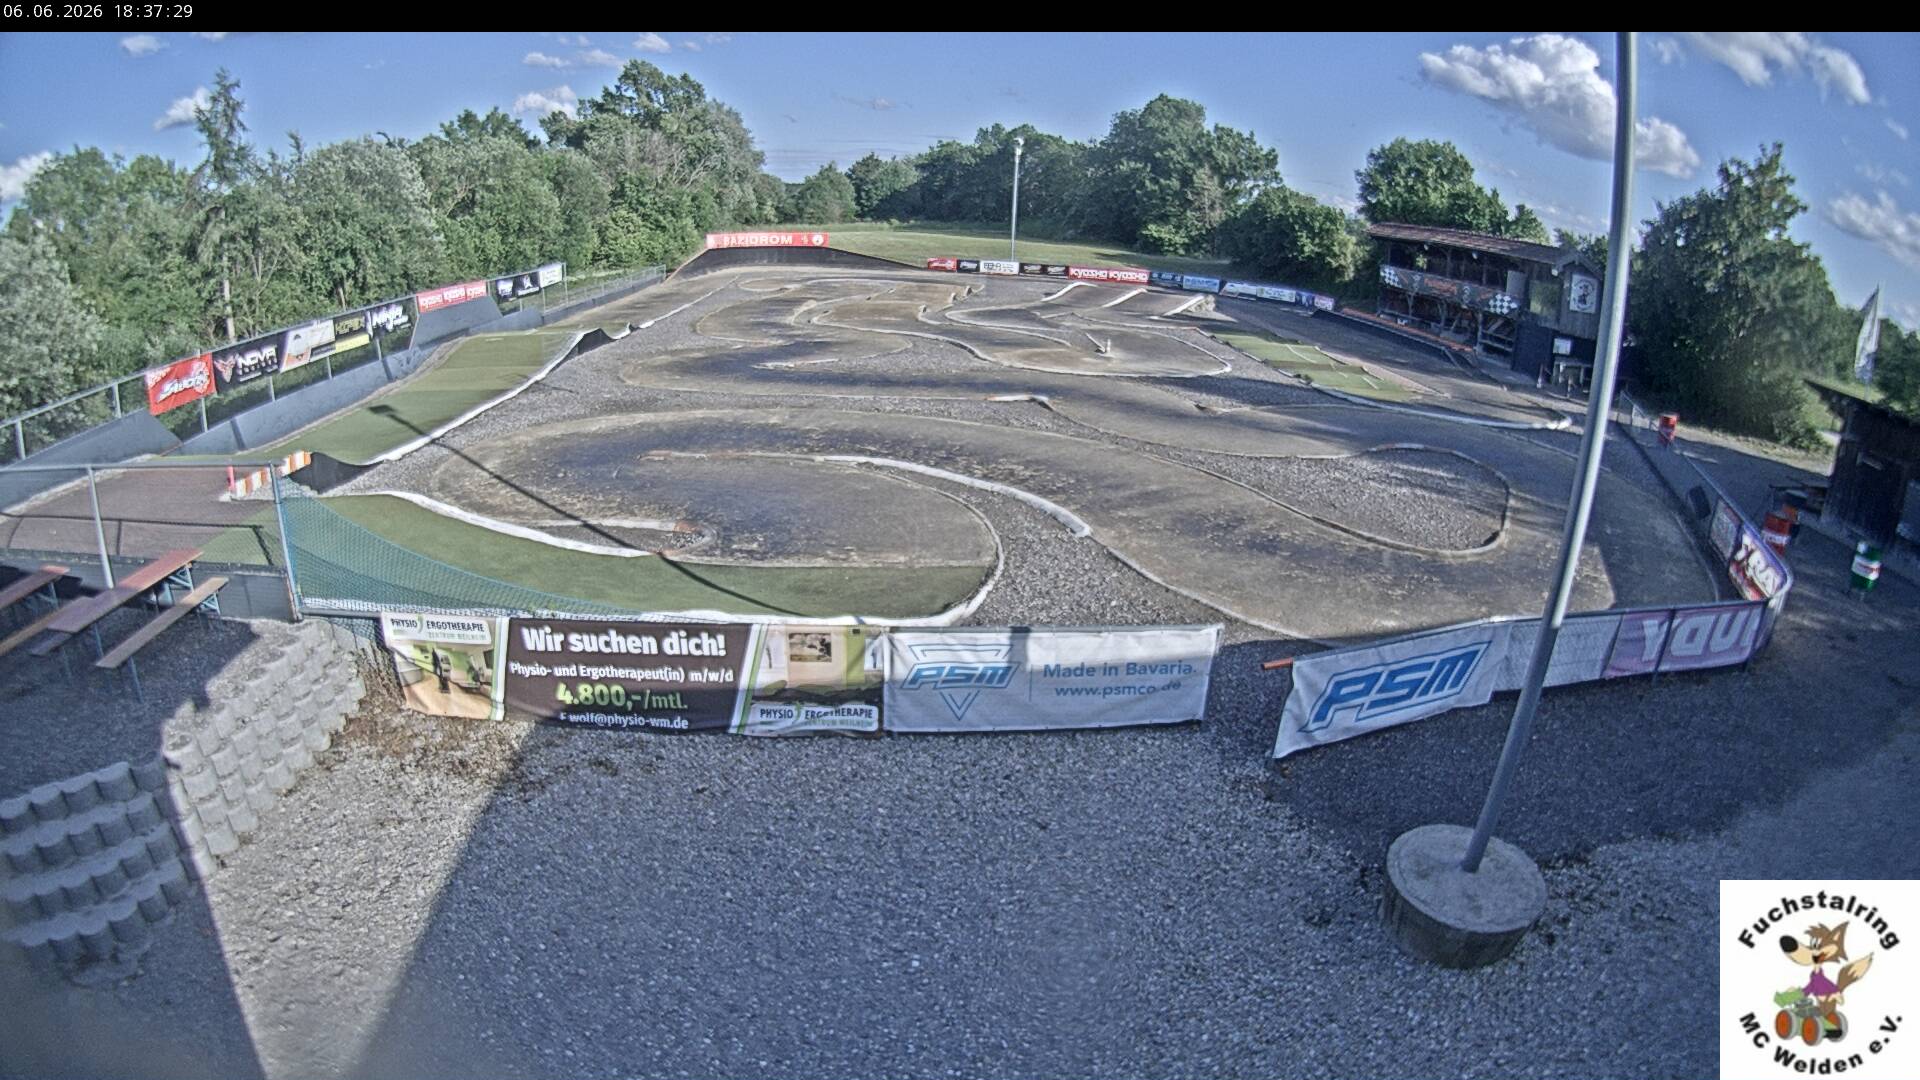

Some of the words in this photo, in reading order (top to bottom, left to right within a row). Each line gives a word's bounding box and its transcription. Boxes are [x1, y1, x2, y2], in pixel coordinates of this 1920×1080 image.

[1070, 268, 1108, 279] KYOSHO
[1109, 270, 1149, 282] KYOSHO
[390, 618, 418, 628] PHYSIO
[426, 620, 485, 632] ERGOTHERAPIE
[522, 625, 564, 652] Wir
[568, 629, 660, 655] suchen
[664, 631, 726, 656] dich!
[510, 662, 552, 677] Physio-
[554, 664, 577, 677] und
[580, 665, 685, 682] Ergotherapeut(in)
[690, 668, 734, 682] m/w/d
[906, 664, 1014, 689] PSM
[1043, 663, 1098, 679] Made
[1102, 662, 1119, 677] in
[1126, 660, 1197, 677] Bavaria.
[1311, 648, 1477, 724] PSM
[569, 712, 689, 729] wolf@physio-wm.de
[760, 708, 794, 719] PHYSIO
